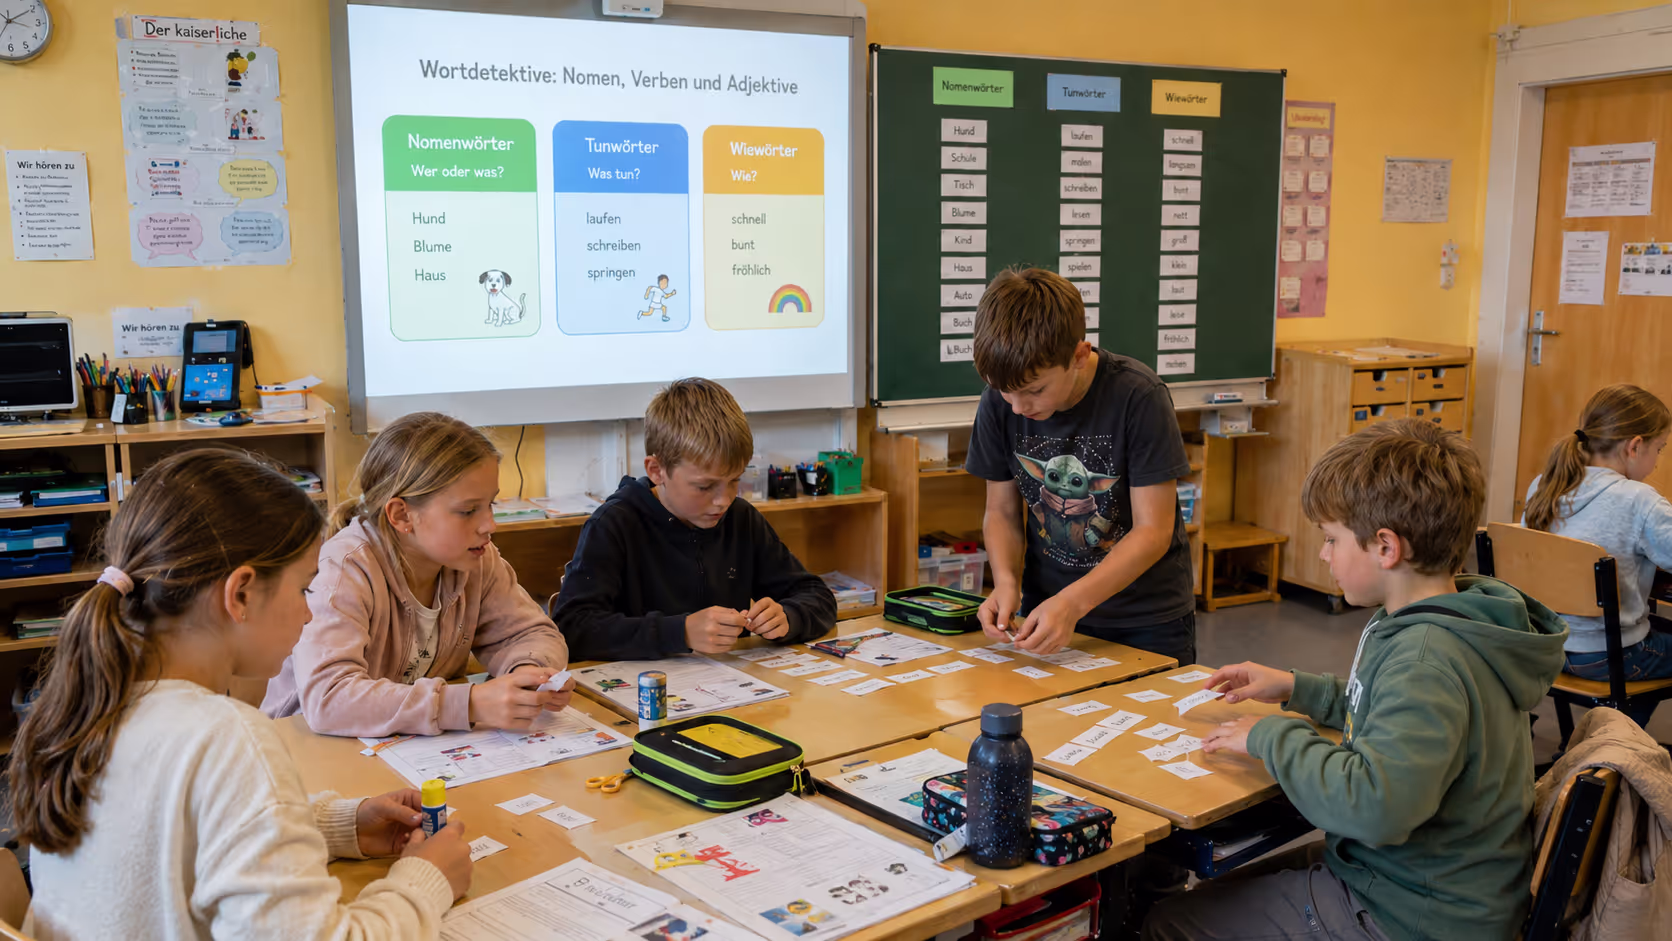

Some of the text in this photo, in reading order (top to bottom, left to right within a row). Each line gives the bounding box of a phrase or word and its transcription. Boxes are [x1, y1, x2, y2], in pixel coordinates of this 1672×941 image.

[30, 5, 35, 13] 2
[35, 19, 41, 27] 3
[145, 21, 171, 36] Der
[8, 43, 14, 52] 6
[22, 41, 29, 49] 5
[419, 59, 798, 96] Wortdetektive: Nomen, Verben und Adjektive
[942, 80, 1004, 94] Nomenwörter
[1062, 86, 1106, 99] Tunwörter
[1165, 92, 1208, 105] Wiewörter
[953, 126, 975, 136] Hund
[1071, 130, 1093, 140] laufen
[408, 133, 514, 151] Nomenwörter
[585, 137, 659, 154] Tunwörter
[730, 141, 798, 158] Wiewörter
[951, 153, 977, 162] Schule
[17, 160, 33, 170] Wir
[35, 160, 62, 170] hören
[411, 164, 504, 178] Wer oder was?
[588, 167, 640, 180] Was tun?
[731, 170, 757, 182] Wie?
[953, 180, 975, 190] Tisch
[1064, 183, 1098, 193] schreiben
[412, 211, 446, 225] Hund
[586, 211, 621, 225] laufen
[731, 212, 766, 225] schnell
[952, 207, 976, 217] Blume
[414, 240, 452, 253] Blume
[587, 238, 641, 252] schreiben
[731, 238, 755, 251] bunt
[955, 235, 973, 245] Kind
[587, 265, 636, 281] springen
[732, 262, 771, 277] fröhlich
[953, 263, 973, 272] Haus
[415, 268, 446, 282] Haus
[953, 290, 973, 300] Auto
[121, 323, 139, 332] Wir
[140, 323, 167, 332] hören
[953, 317, 973, 328] Buch
